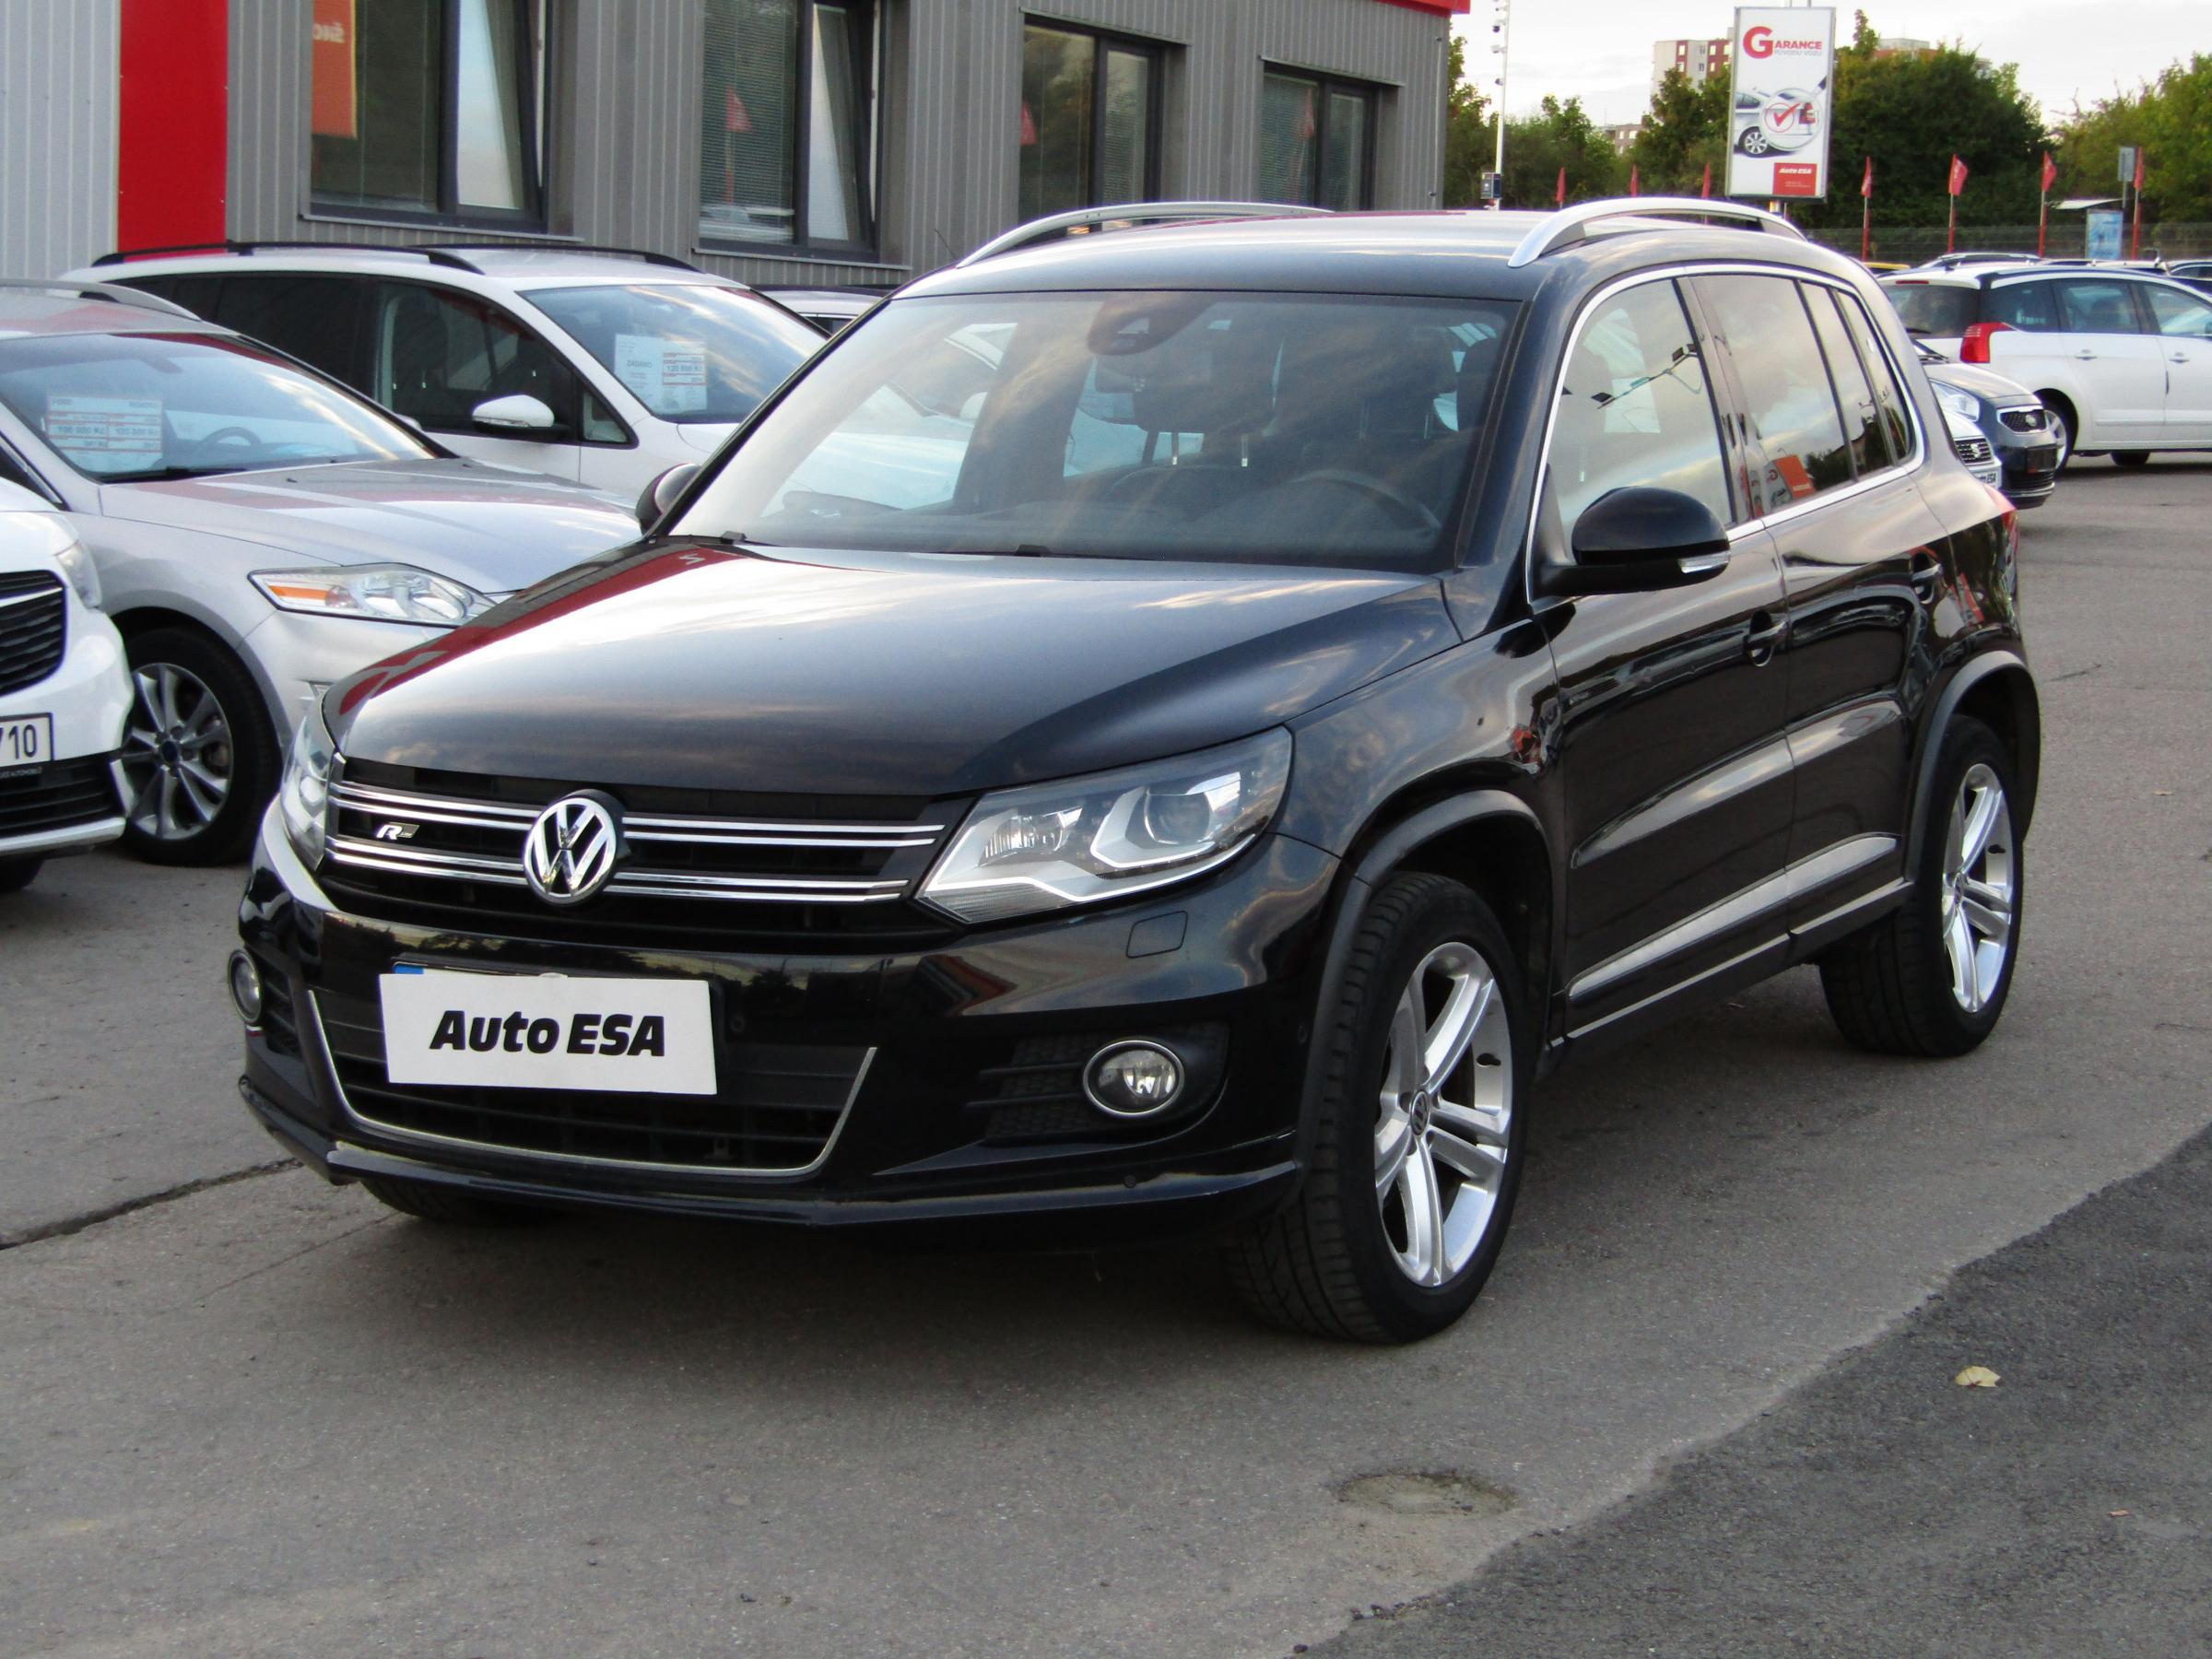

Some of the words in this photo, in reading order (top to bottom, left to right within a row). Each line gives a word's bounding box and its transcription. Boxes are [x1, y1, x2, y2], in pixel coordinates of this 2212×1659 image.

[1743, 26, 1822, 59] GARANCE
[429, 1010, 560, 1053] Auto
[567, 1014, 665, 1057] ESA
